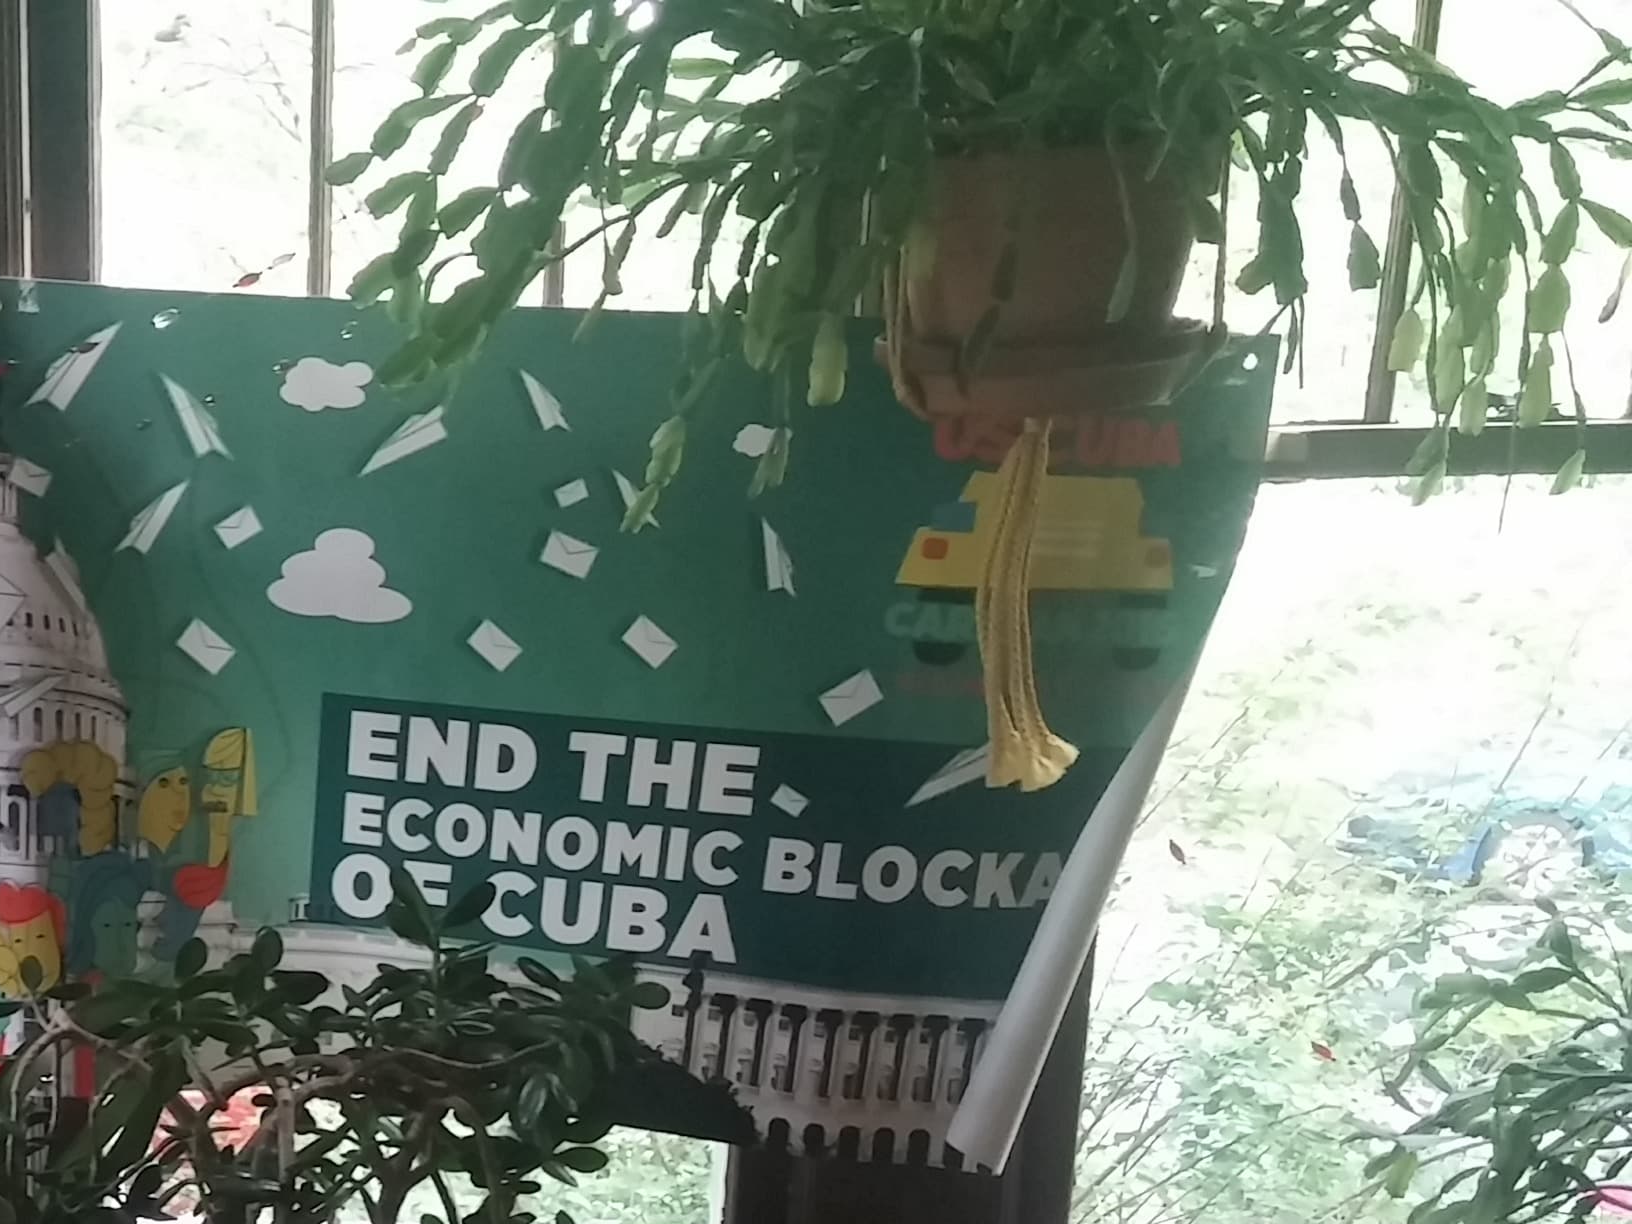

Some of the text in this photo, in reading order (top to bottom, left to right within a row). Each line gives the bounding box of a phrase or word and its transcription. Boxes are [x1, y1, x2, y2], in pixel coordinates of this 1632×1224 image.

[346, 710, 760, 816] END THE
[343, 793, 744, 888] ECONOMIC
[331, 854, 736, 964] OF CUBA
